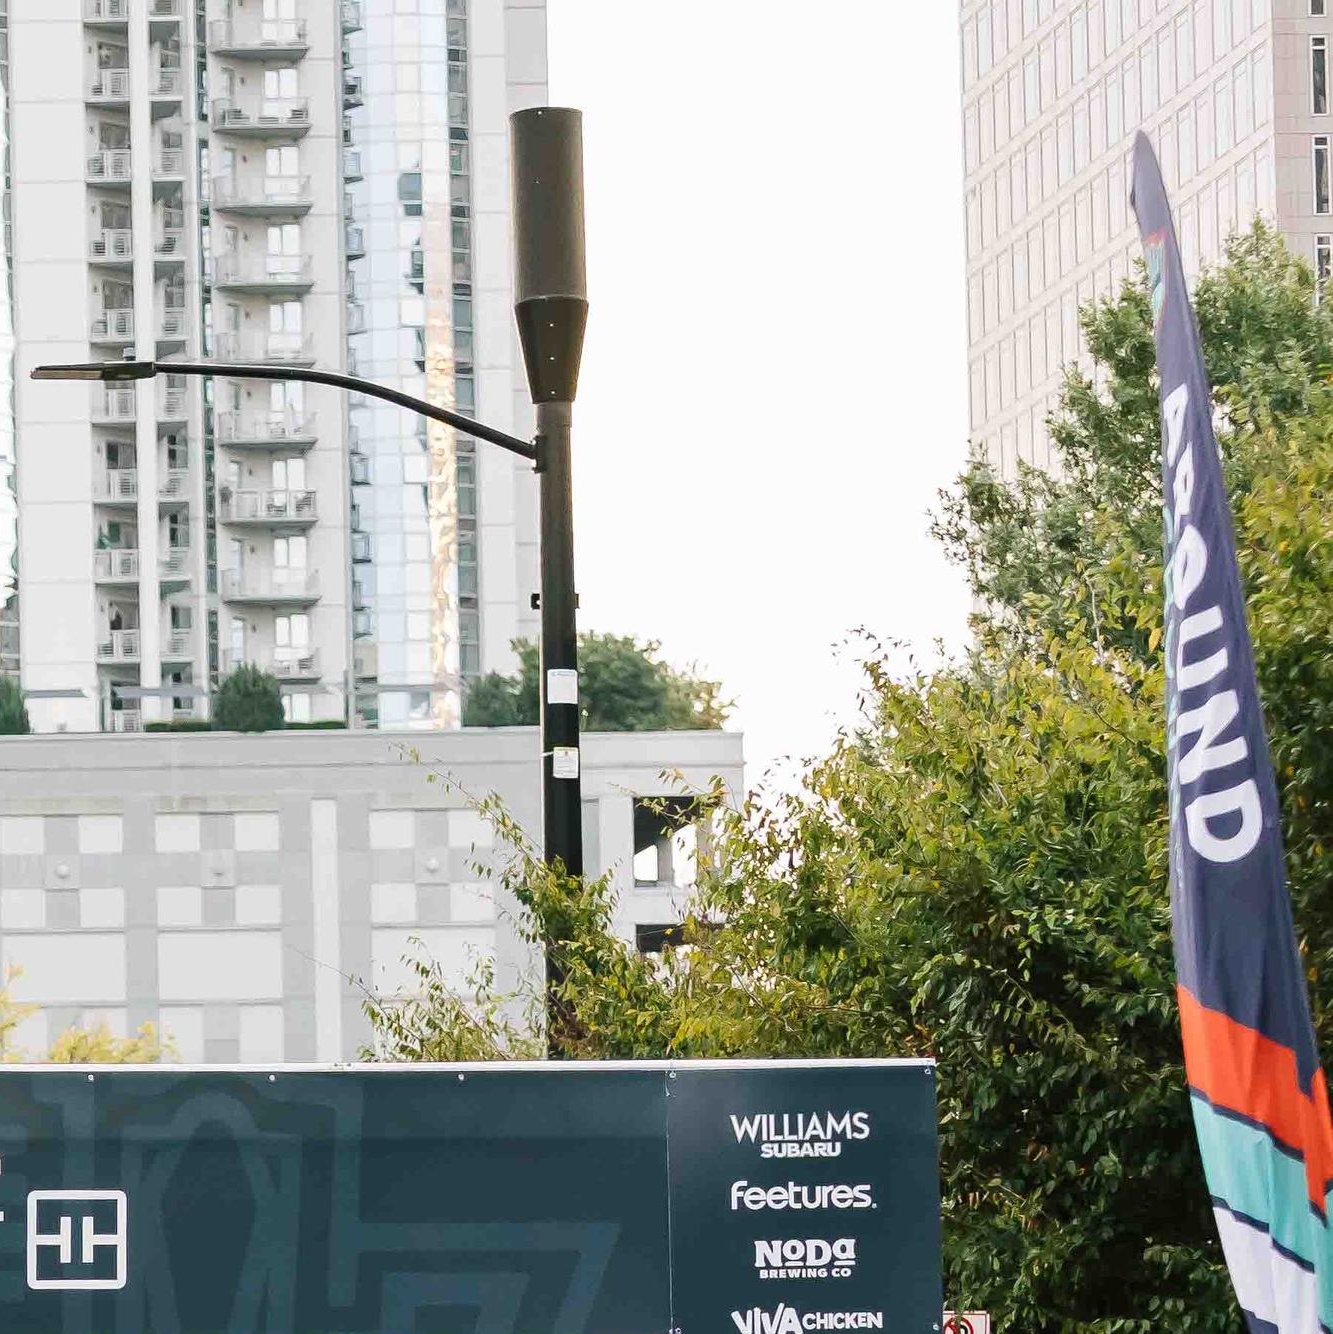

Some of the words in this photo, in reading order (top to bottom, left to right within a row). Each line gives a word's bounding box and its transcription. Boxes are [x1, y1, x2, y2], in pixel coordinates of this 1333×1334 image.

[729, 1111, 870, 1143] WILLIAMS
[761, 1142, 841, 1158] SUBARU
[759, 1268, 828, 1279] BREWING
[831, 1268, 851, 1279] CO
[802, 1311, 883, 1330] CHICKEN
